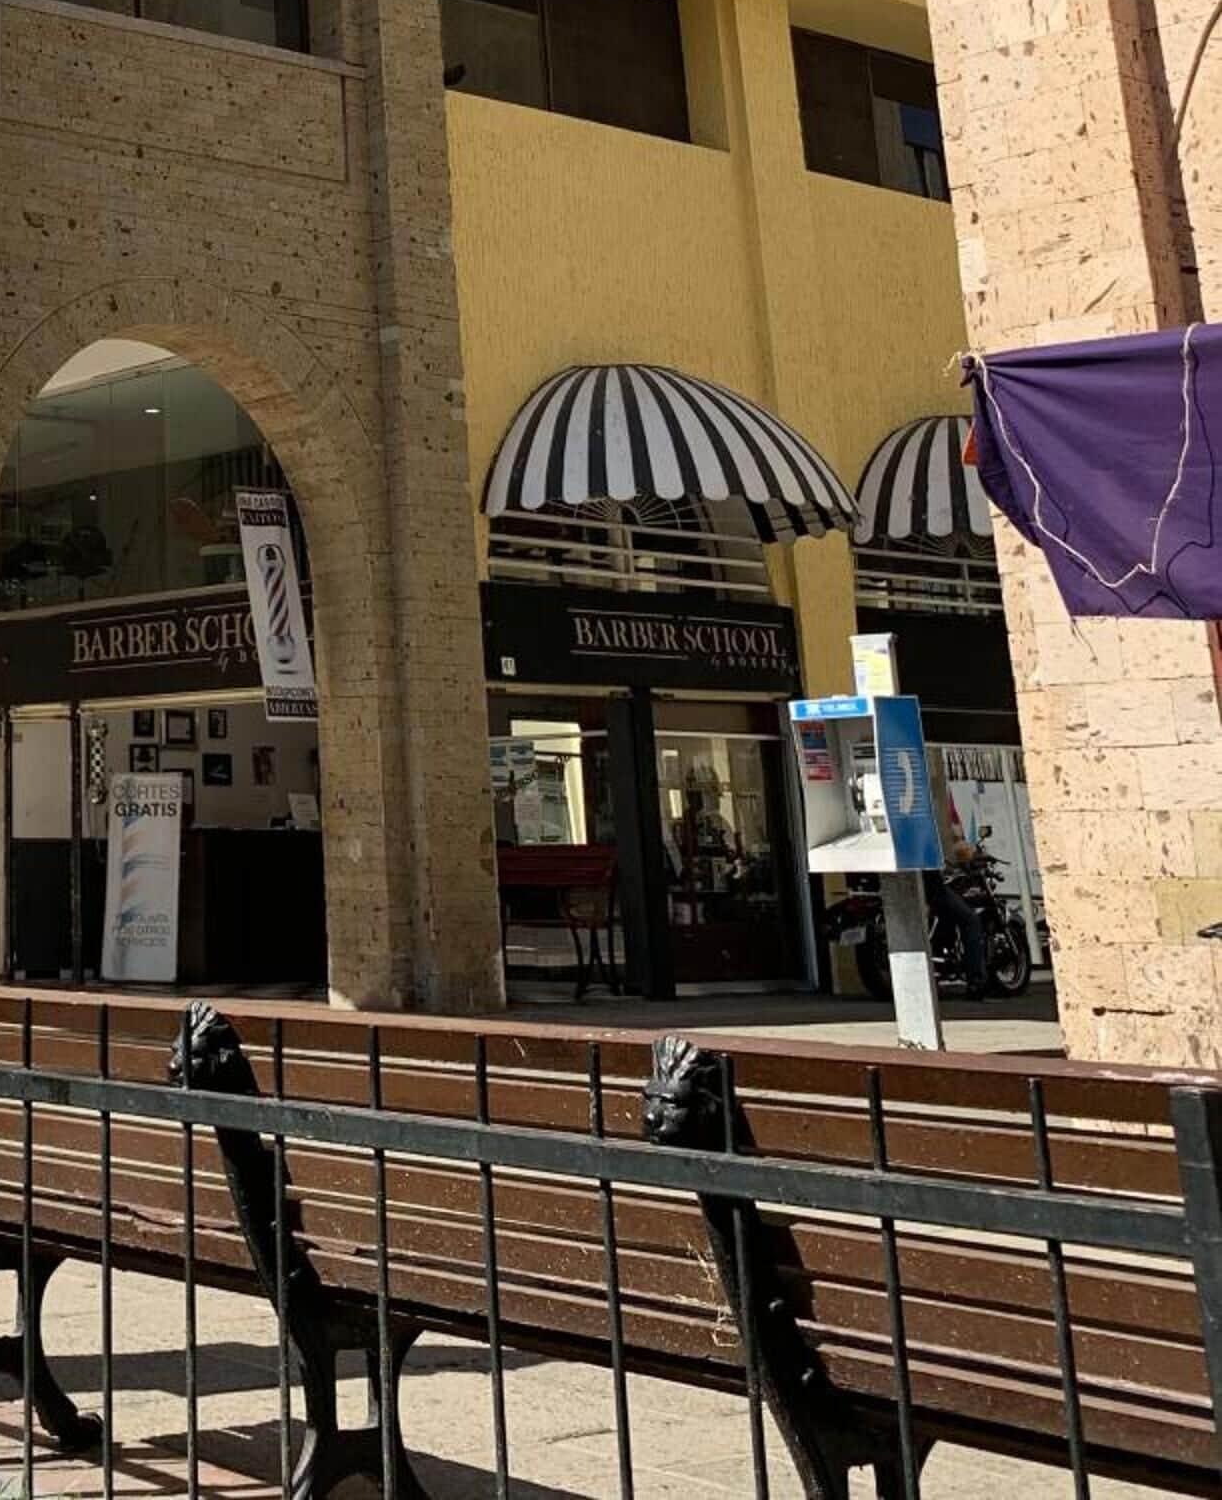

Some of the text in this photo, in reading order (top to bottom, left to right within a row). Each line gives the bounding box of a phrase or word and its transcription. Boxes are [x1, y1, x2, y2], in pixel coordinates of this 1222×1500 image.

[73, 620, 178, 663] BARBER
[185, 612, 257, 653] SCHO
[574, 616, 786, 657] BARBER SCHOOL
[112, 783, 180, 800] CORTES
[114, 802, 178, 817] GRATIS
